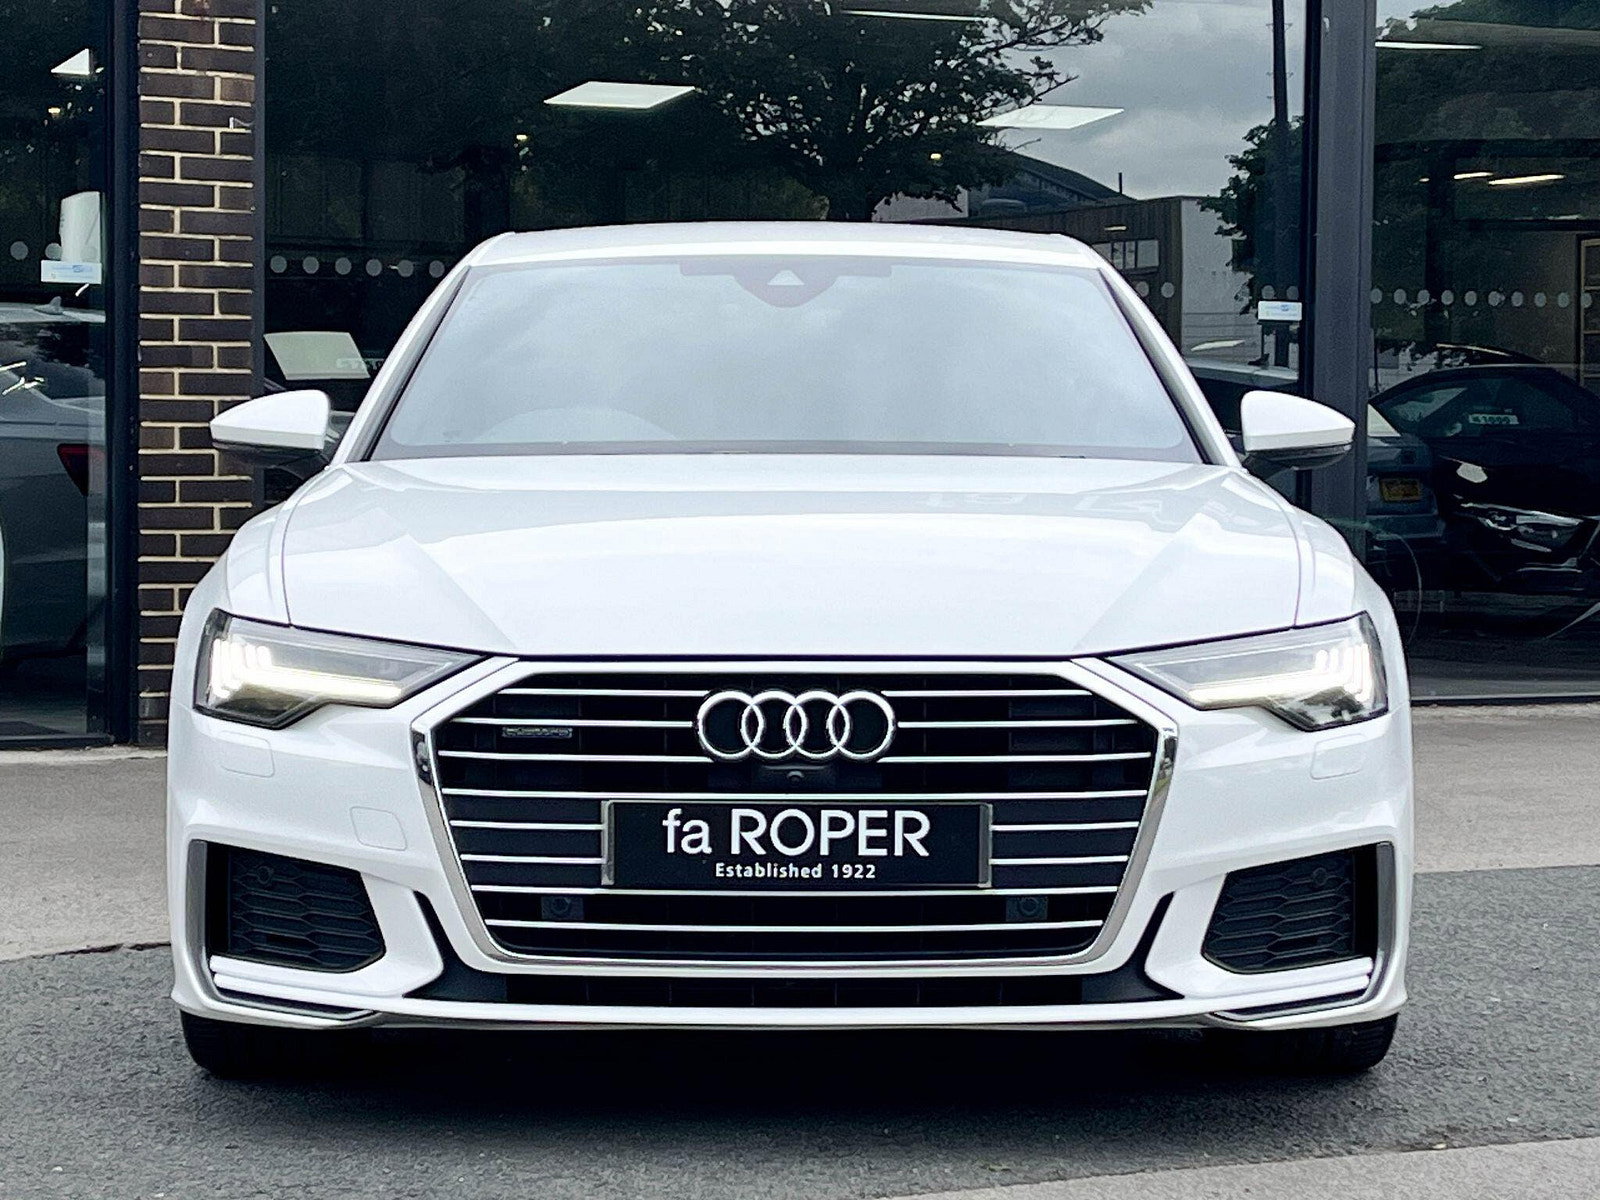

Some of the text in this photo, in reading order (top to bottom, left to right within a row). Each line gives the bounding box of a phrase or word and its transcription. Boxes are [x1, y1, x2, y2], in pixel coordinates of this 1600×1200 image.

[662, 807, 931, 857] fa ROPER
[715, 862, 876, 879] Established 1922
